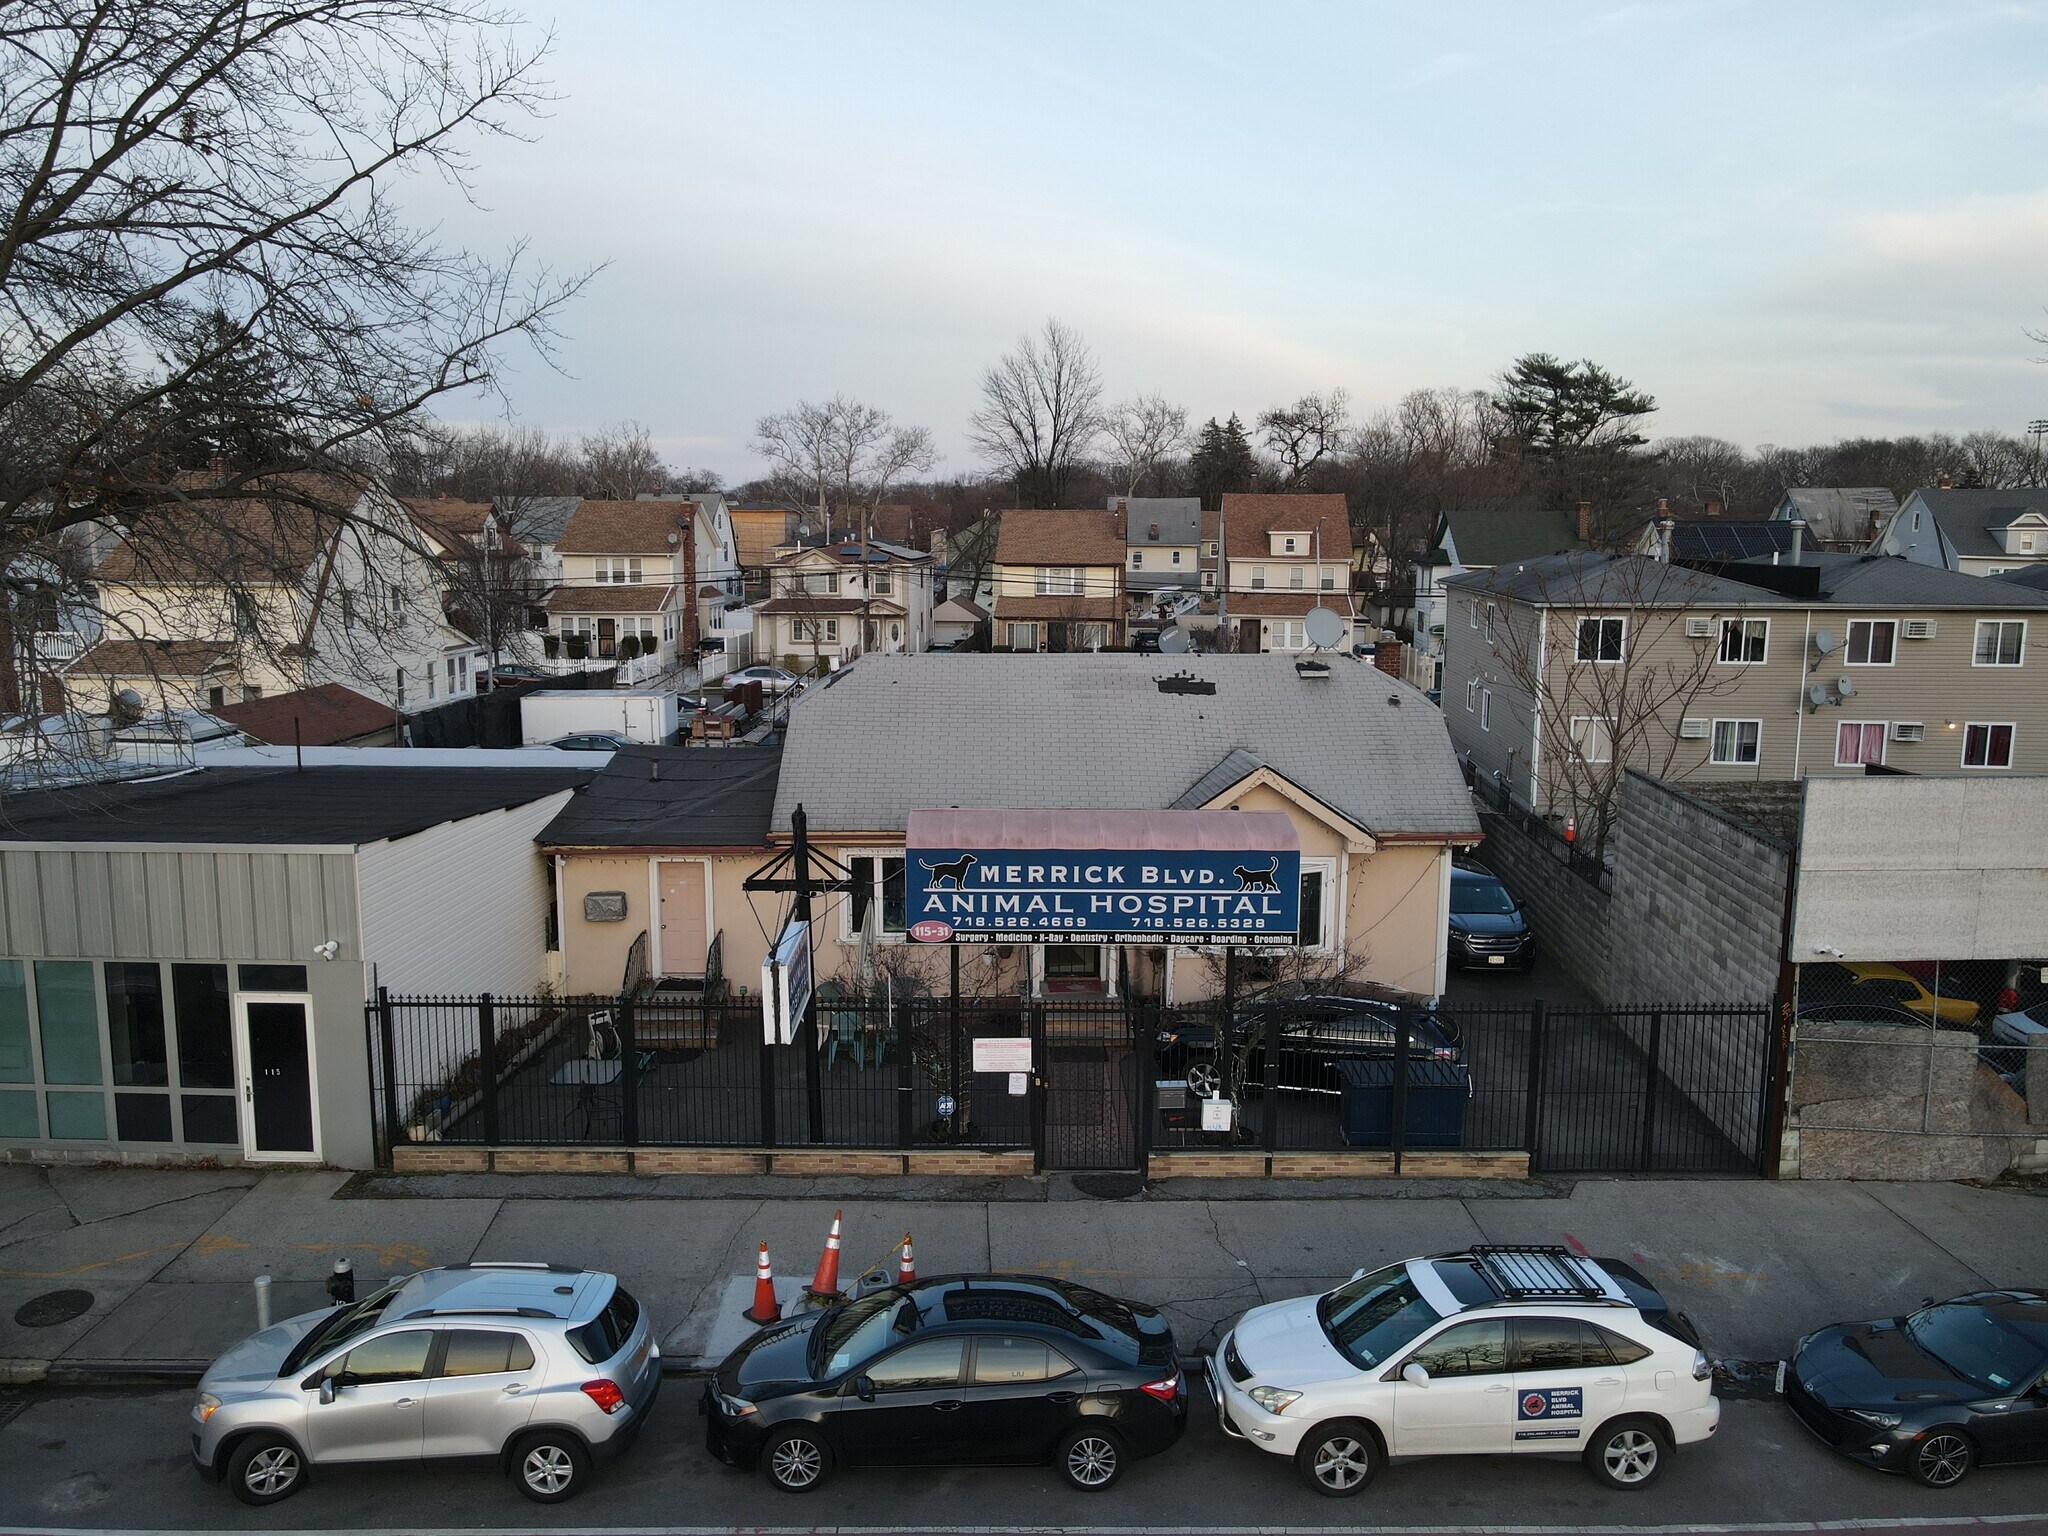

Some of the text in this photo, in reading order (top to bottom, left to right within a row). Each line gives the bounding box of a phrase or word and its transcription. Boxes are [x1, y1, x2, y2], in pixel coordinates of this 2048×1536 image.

[980, 865, 1226, 885] MERRICK BLVD.
[923, 895, 1282, 915] ANIMAL HOSPITAL
[952, 916, 1087, 927] 718.526.4669
[1131, 917, 1266, 928] 718.526.5328
[915, 926, 949, 937] 115-31
[955, 933, 1293, 945] Surgery Medicine X-Ray Dentistry Orthophedic Daycare Boarding Grooming
